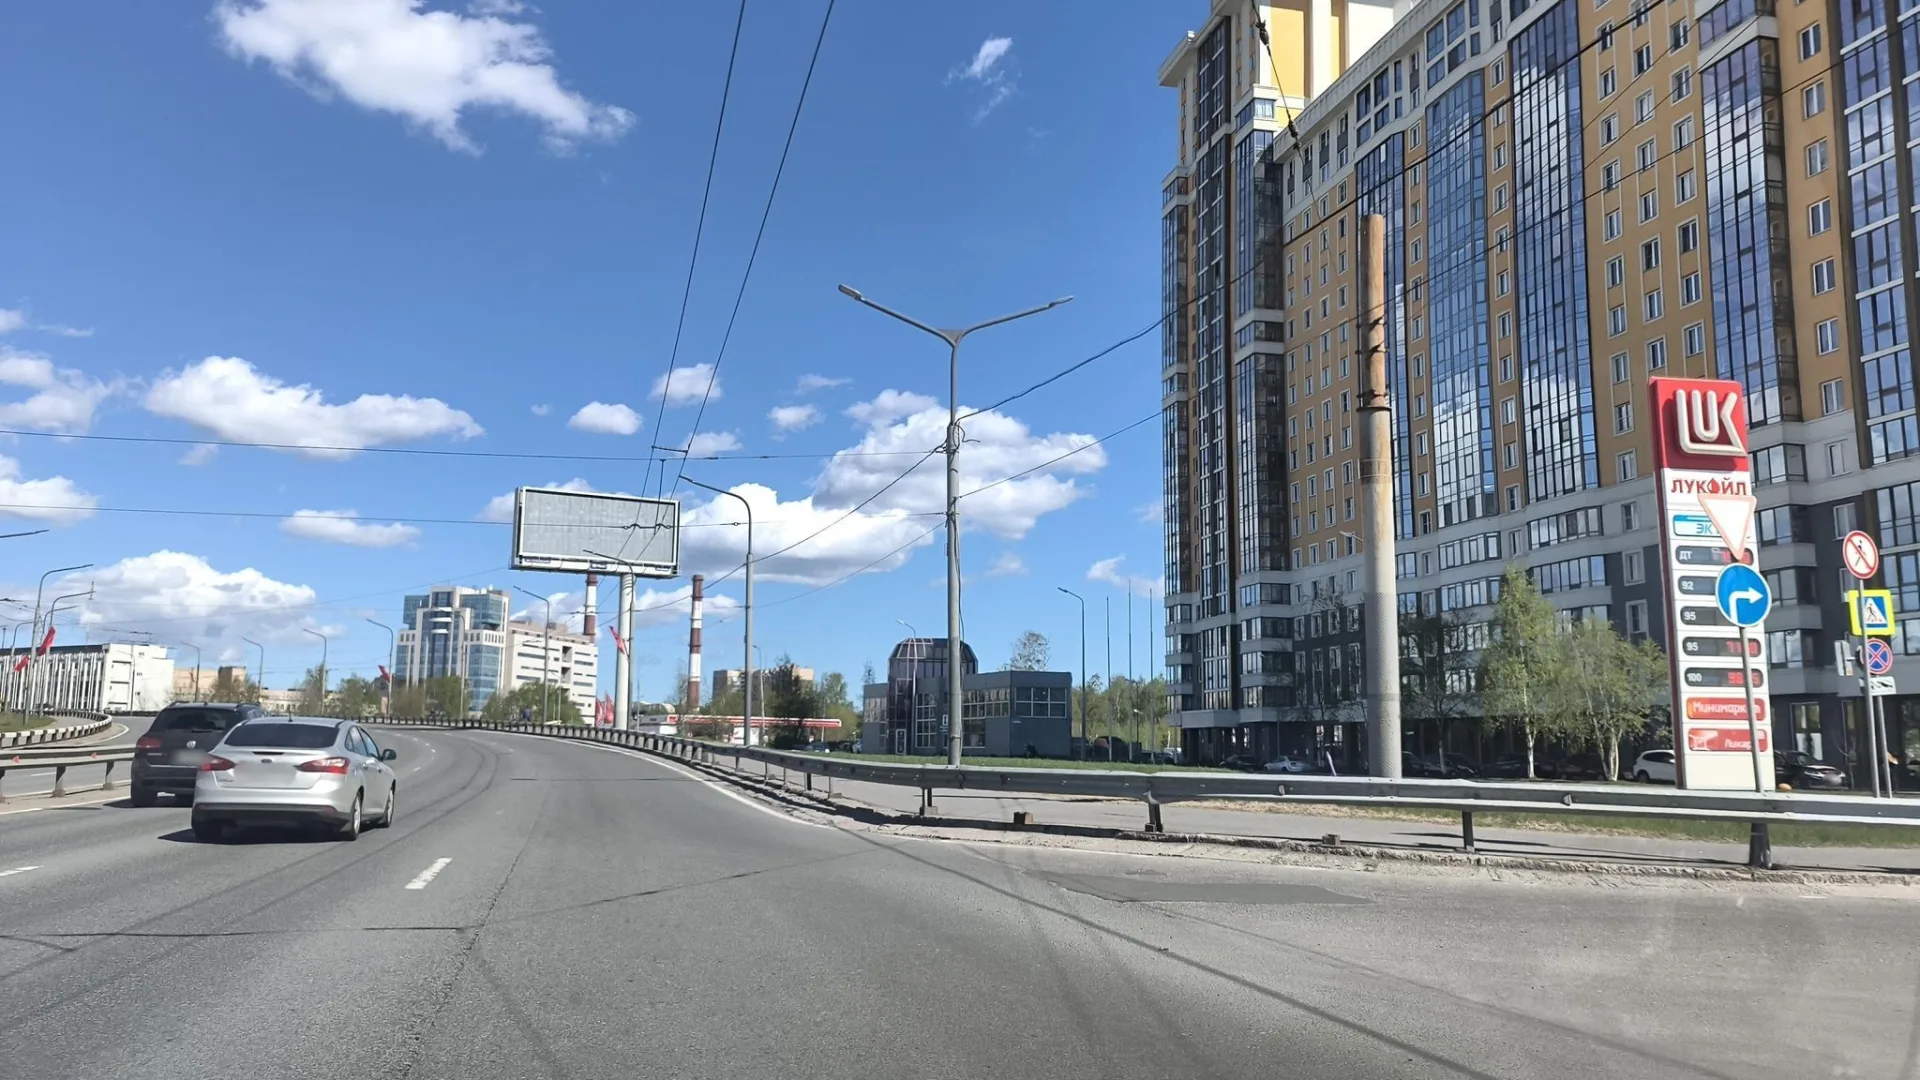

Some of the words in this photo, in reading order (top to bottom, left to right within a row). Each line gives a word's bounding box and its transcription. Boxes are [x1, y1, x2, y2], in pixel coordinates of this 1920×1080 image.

[1671, 477, 1747, 495] ЛУКОЙЛ
[1679, 550, 1693, 561] ДТ
[1681, 581, 1694, 591] 92
[1683, 611, 1696, 621] 95
[1686, 641, 1699, 651] 95
[1686, 672, 1702, 682] 100
